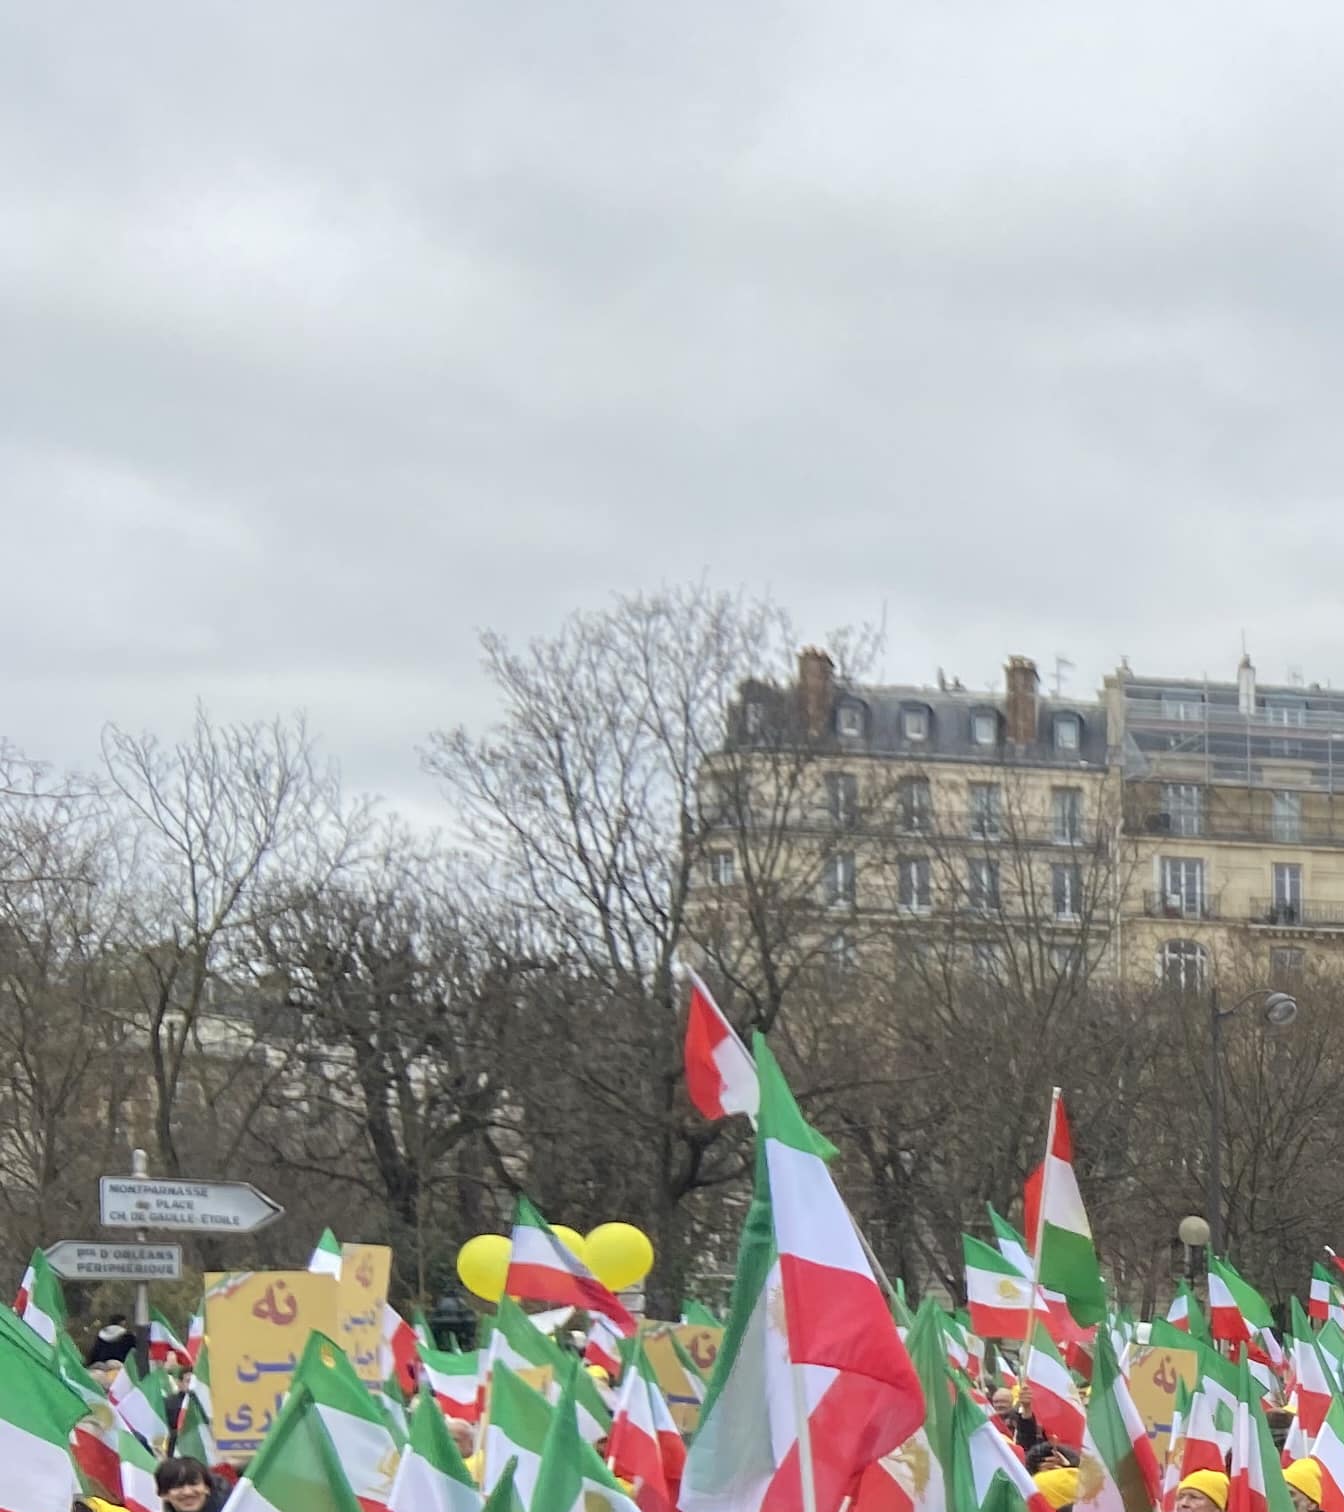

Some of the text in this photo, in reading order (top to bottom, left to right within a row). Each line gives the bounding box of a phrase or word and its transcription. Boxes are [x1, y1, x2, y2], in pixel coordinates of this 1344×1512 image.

[109, 1184, 208, 1198] MONTPARNASSE
[155, 1199, 194, 1210] PLACE
[252, 1279, 297, 1326] نه
[1152, 1354, 1177, 1394] نه
